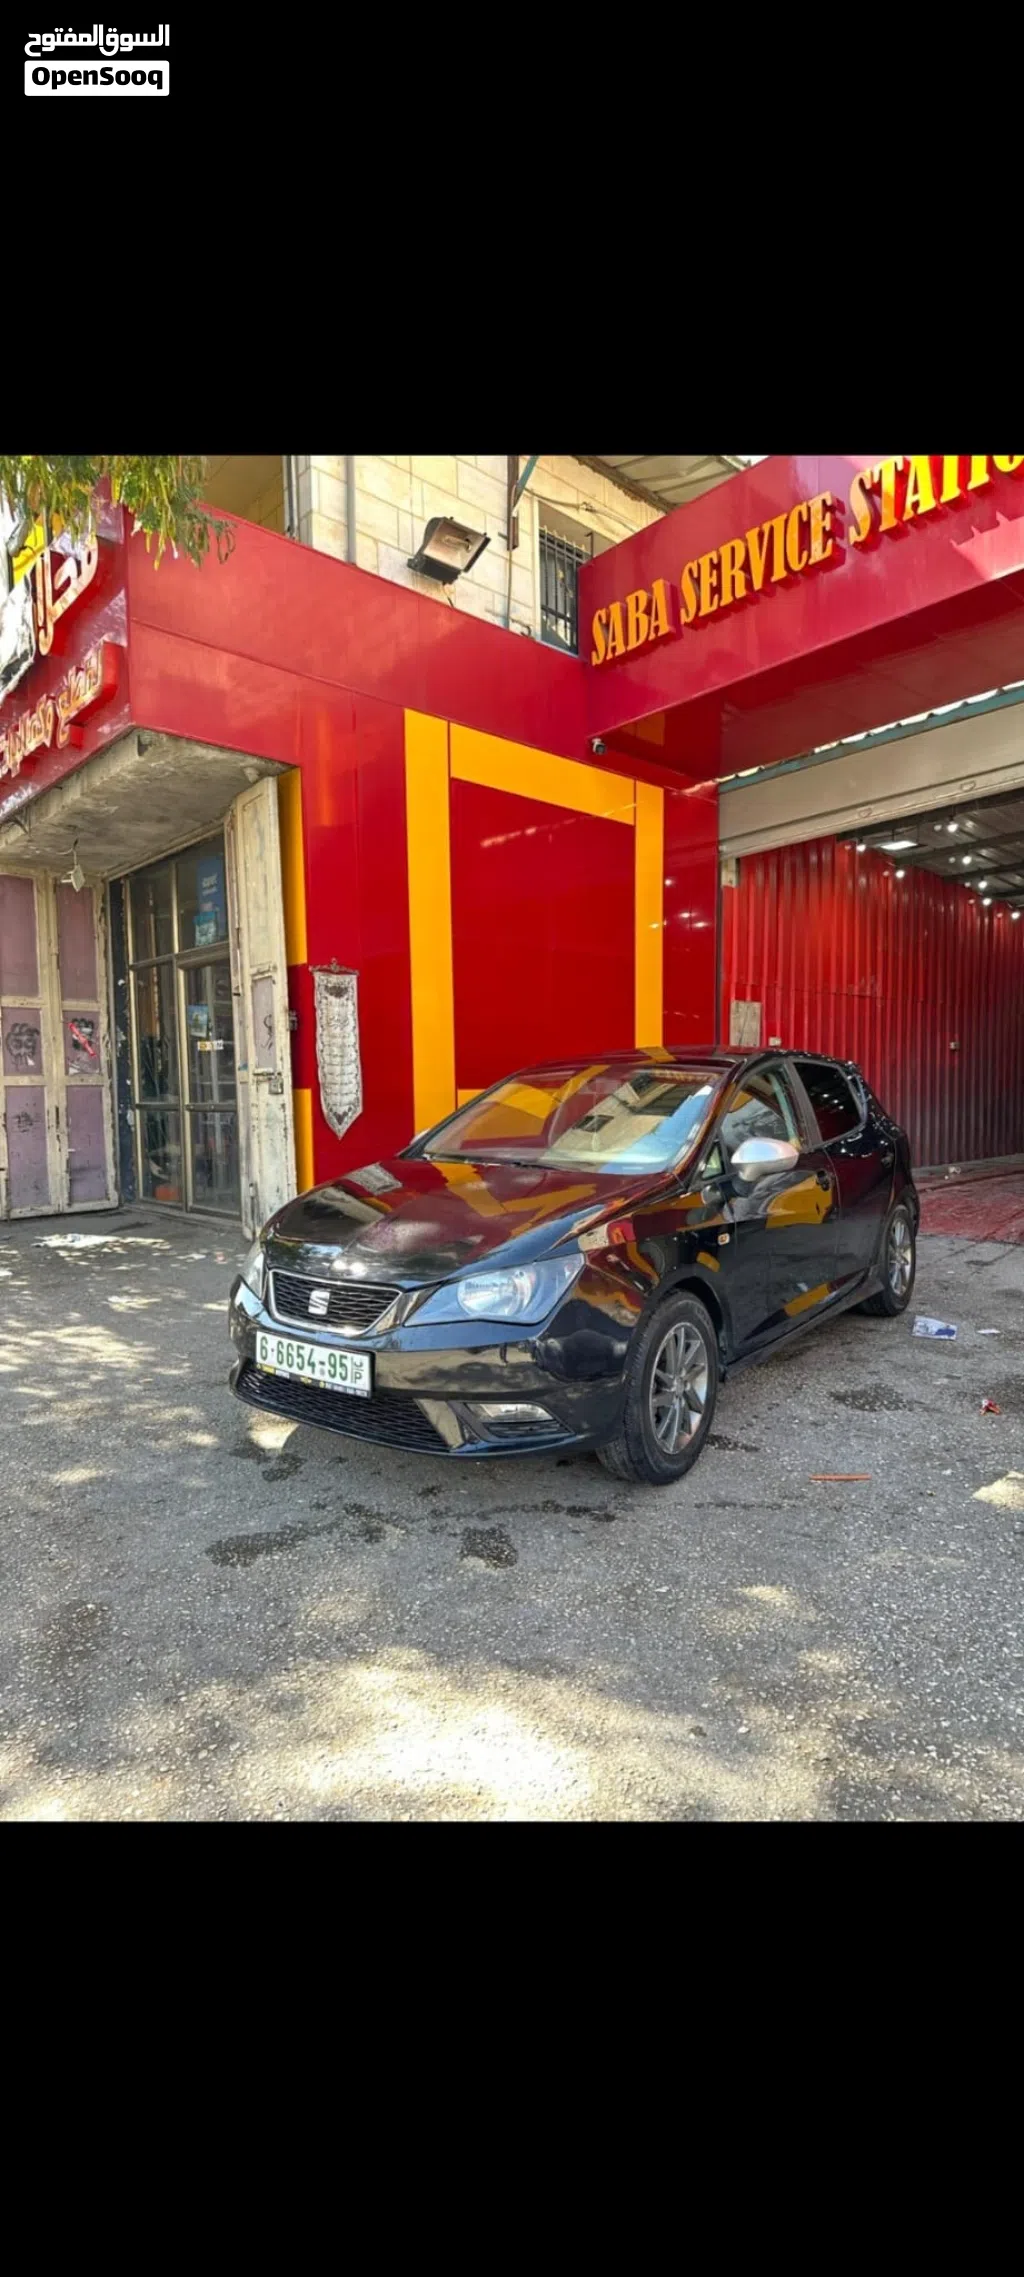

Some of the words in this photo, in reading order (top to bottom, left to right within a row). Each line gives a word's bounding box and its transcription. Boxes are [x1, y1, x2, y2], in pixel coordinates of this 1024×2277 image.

[591, 578, 671, 666] SABA
[680, 491, 833, 624] SERVICE
[849, 456, 1024, 545] STAT
